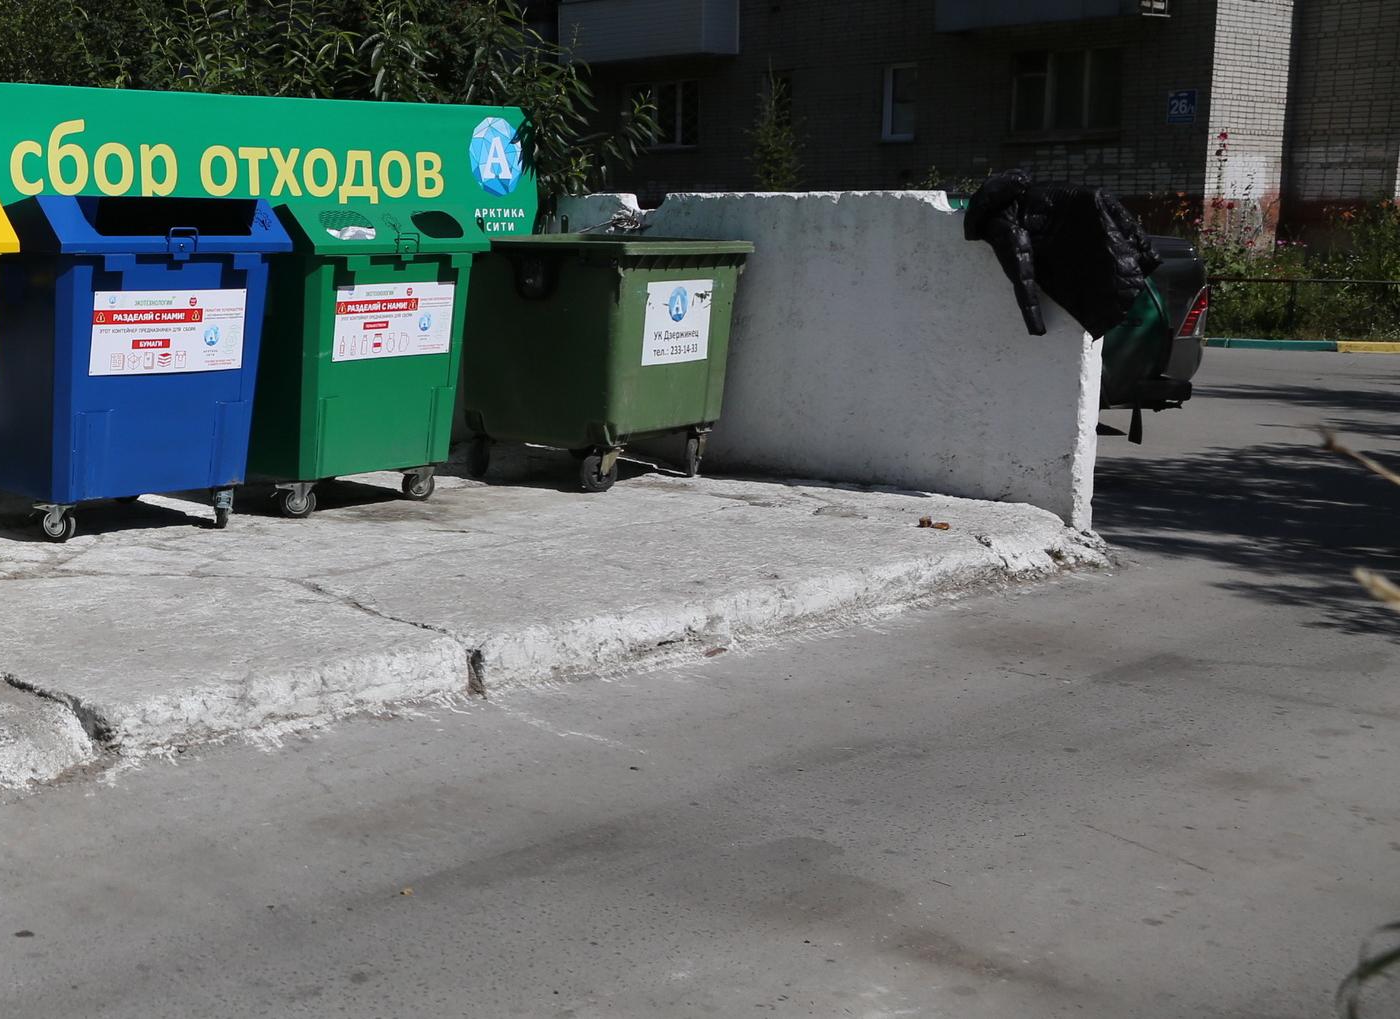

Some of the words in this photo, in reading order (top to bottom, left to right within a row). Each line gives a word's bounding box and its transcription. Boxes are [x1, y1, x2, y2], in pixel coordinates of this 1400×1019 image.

[9, 118, 179, 197] сбор
[200, 145, 445, 204] отходов
[474, 207, 526, 218] АРКТИКА
[486, 221, 516, 232] СИТИ
[382, 302, 387, 310] С
[112, 311, 153, 323] РАЗДЕЛЯЙ
[154, 313, 161, 321] С
[161, 312, 186, 320] НАМИ!
[653, 330, 663, 341] УК
[663, 329, 699, 342] Дзержинец
[139, 340, 163, 348] БУМАГИ
[670, 343, 698, 355] 233-14-33
